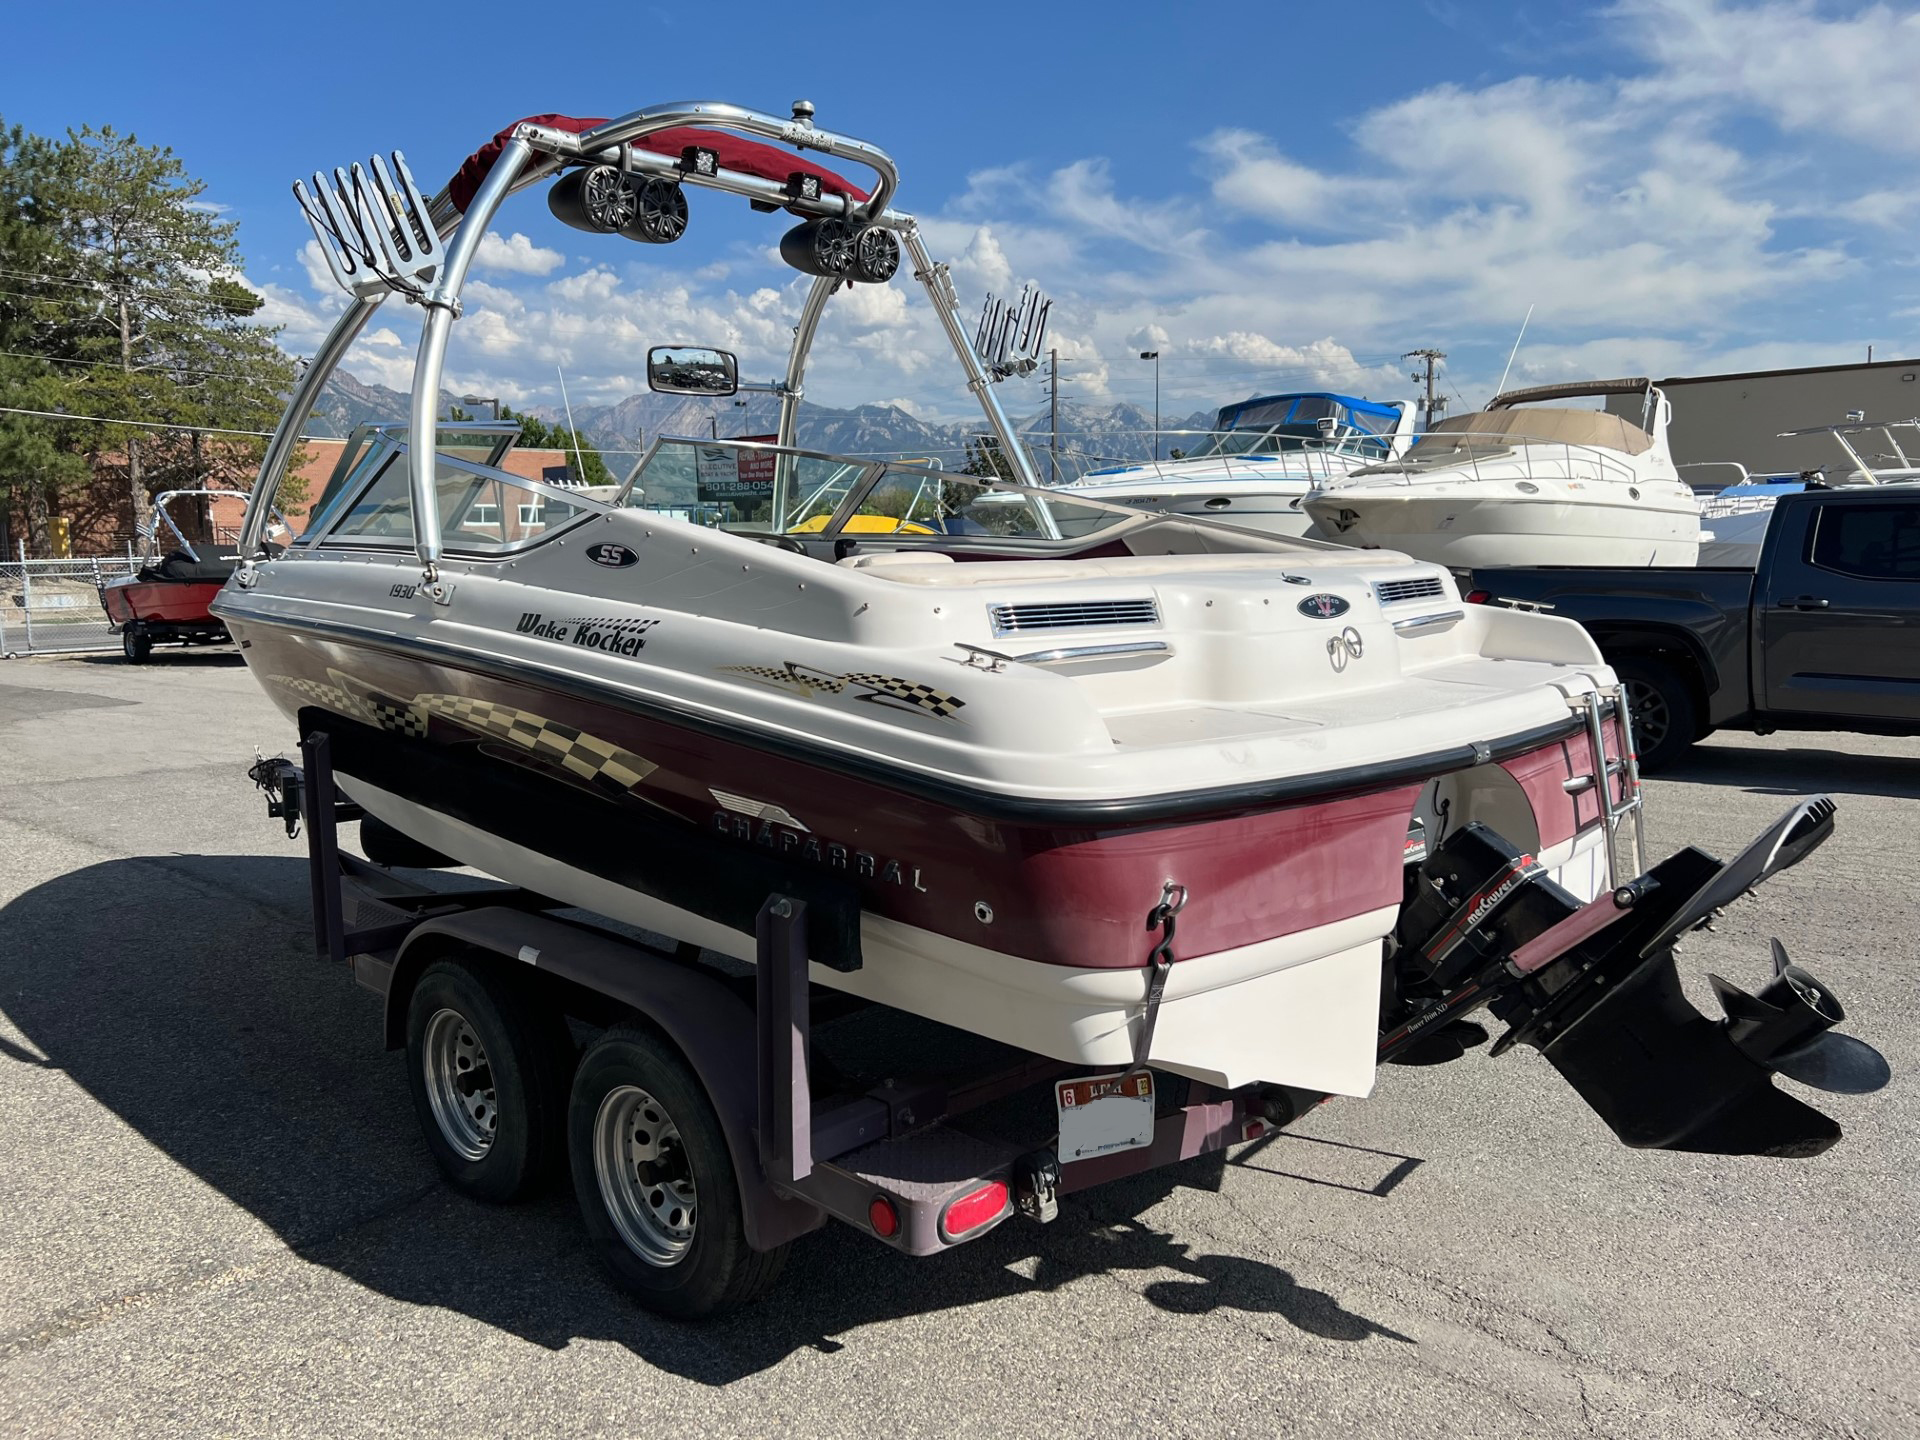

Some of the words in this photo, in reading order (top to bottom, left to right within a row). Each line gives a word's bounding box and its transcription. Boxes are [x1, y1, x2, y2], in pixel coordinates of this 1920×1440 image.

[597, 545, 624, 564] SS
[389, 584, 416, 599] 1930
[516, 613, 568, 641] Wake
[572, 625, 646, 657] Rocker
[713, 811, 927, 892] CHAPARRAL
[1435, 1003, 1448, 1015] XD
[1065, 1091, 1072, 1105] 6
[1089, 1083, 1122, 1098] UTH
